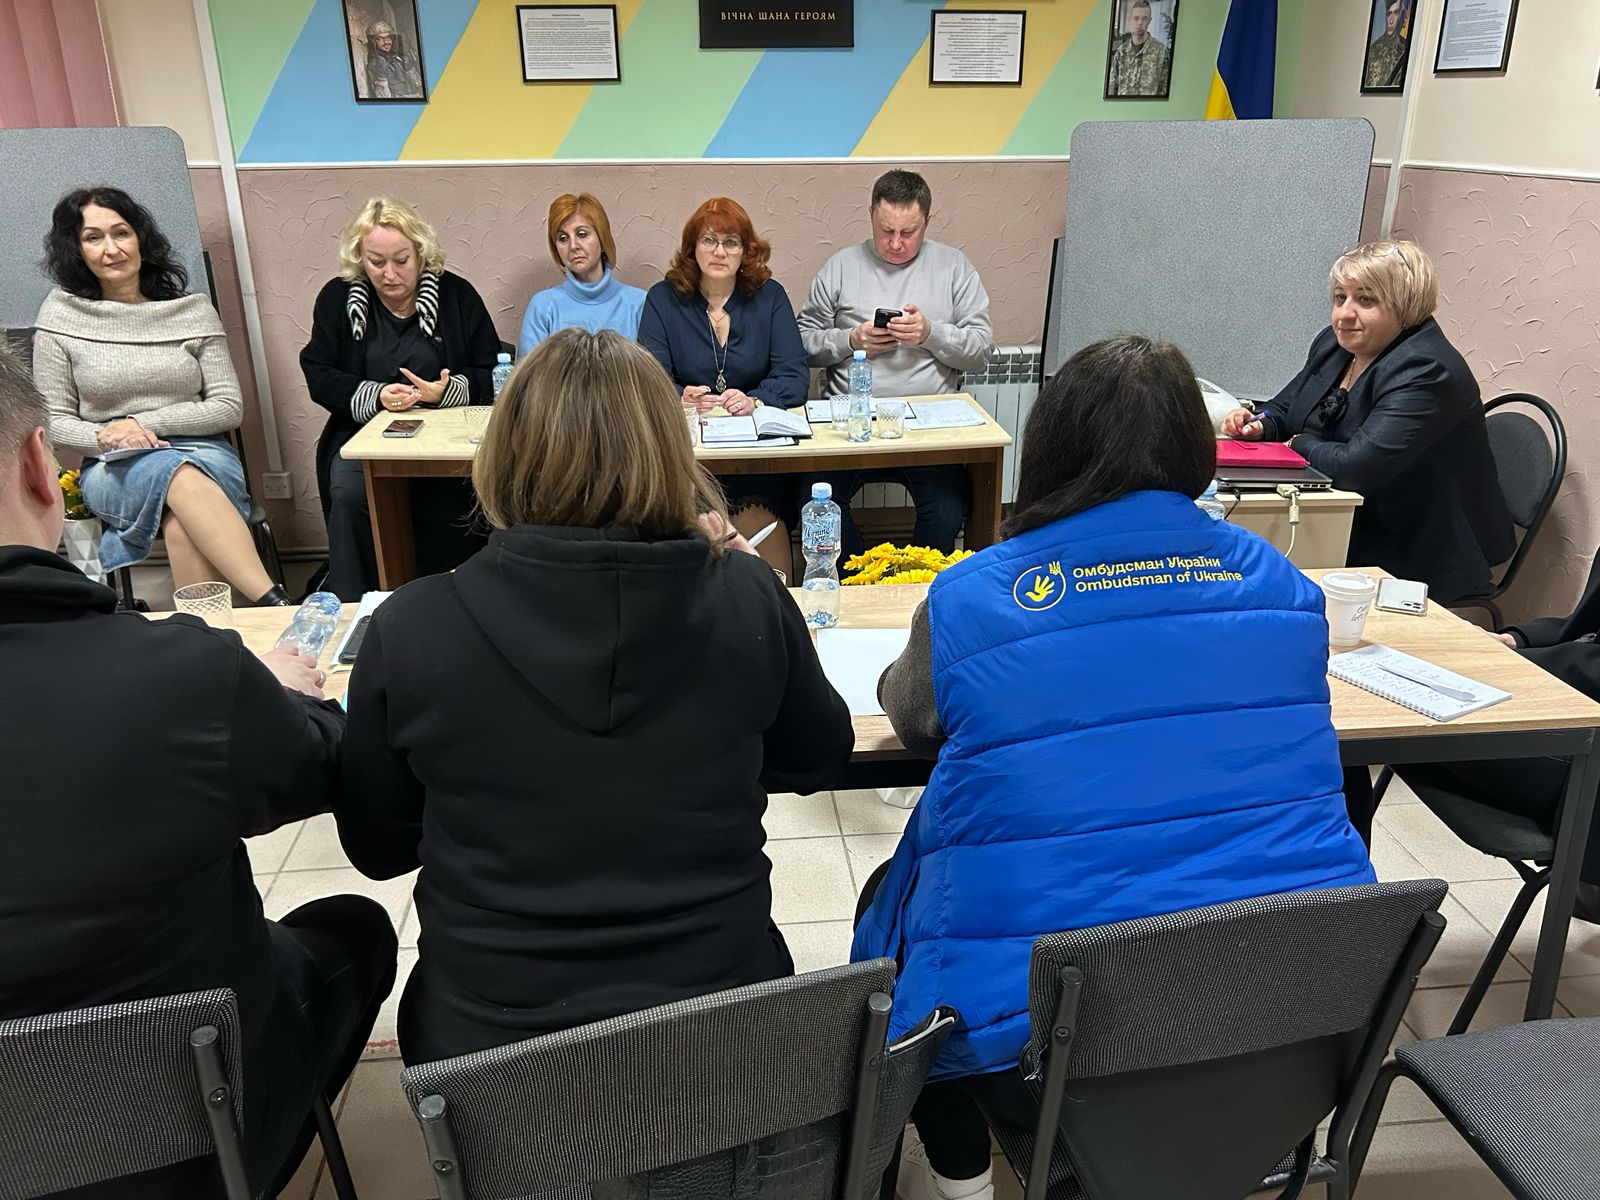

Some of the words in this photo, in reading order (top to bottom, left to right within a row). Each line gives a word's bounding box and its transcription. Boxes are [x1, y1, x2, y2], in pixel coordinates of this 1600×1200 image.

[720, 11, 754, 21] ВІЧНА
[758, 11, 791, 21] ШАНА
[794, 11, 837, 21] ГЕРОЯМ
[1072, 558, 1165, 579] Омбудсман
[1166, 555, 1221, 572] України
[1075, 573, 1173, 593] Ombudsman
[1175, 572, 1191, 584] of
[1194, 570, 1243, 583] Ukraine
